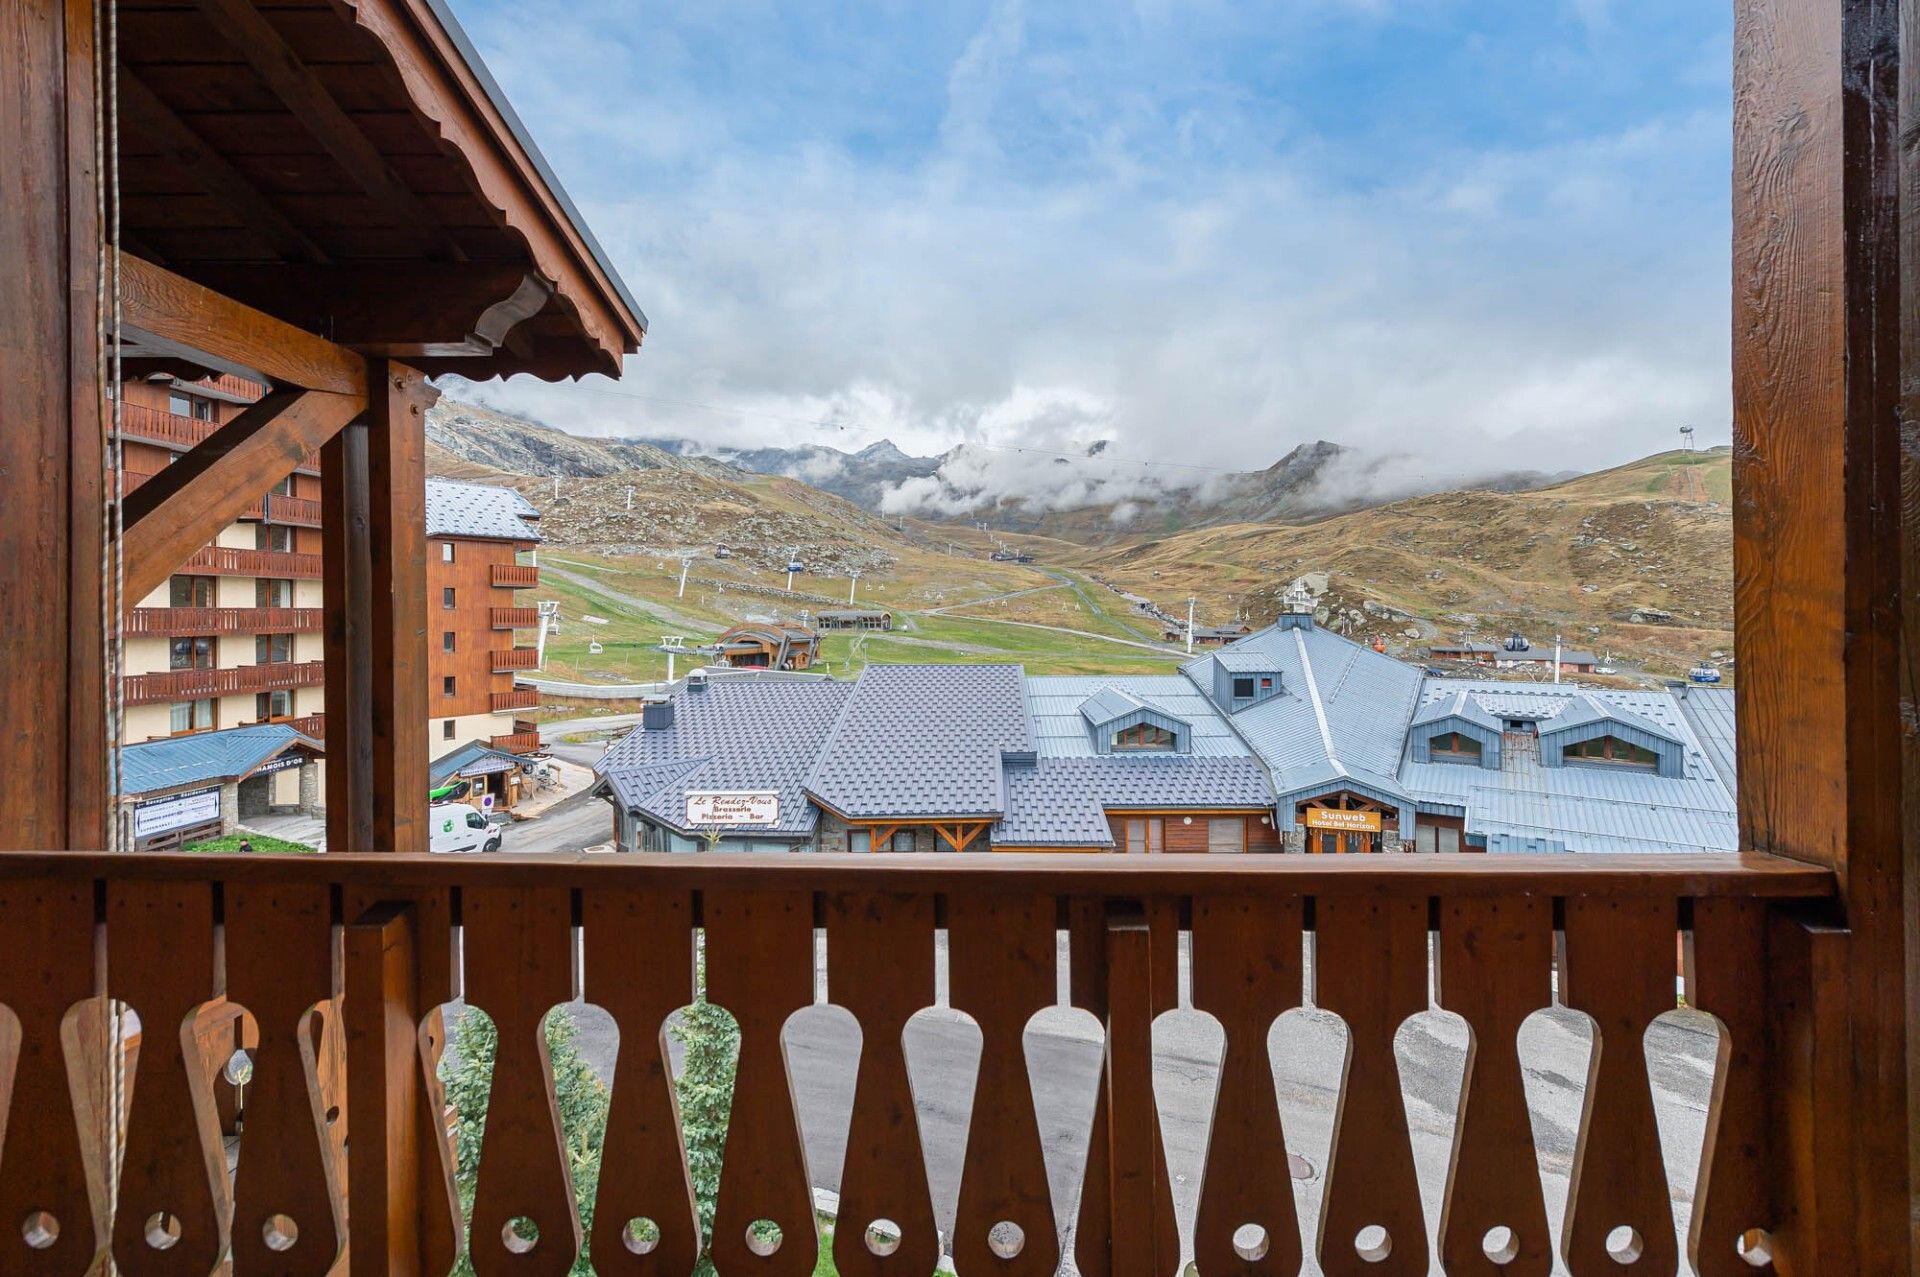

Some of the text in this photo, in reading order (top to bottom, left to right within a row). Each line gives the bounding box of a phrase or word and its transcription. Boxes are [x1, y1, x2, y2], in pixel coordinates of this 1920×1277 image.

[693, 796, 772, 807] Le Rendez-Vous
[1321, 811, 1366, 822] Sunweb
[1312, 819, 1332, 827] Hotel
[1346, 822, 1376, 830] Horizon
